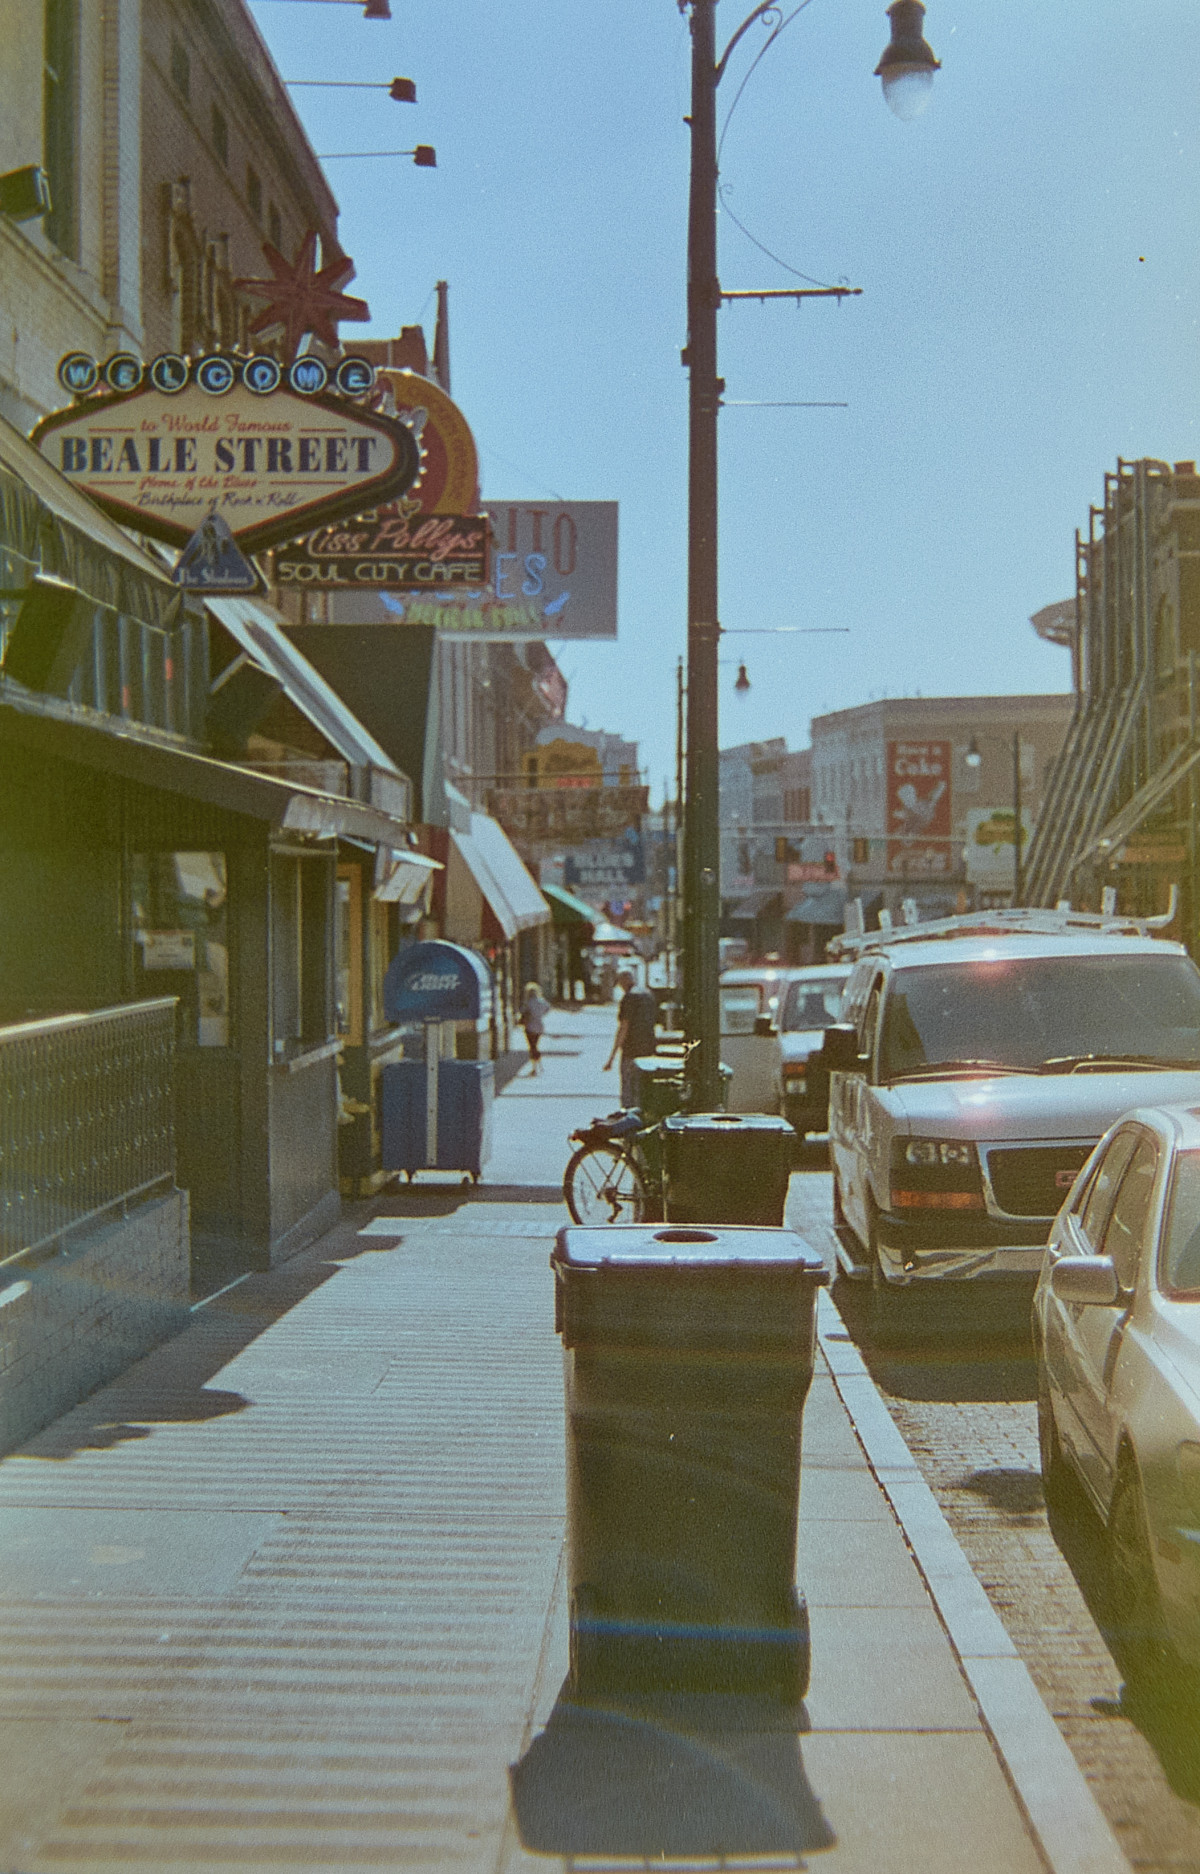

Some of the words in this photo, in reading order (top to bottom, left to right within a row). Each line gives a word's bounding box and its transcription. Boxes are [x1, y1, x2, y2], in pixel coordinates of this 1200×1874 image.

[67, 359, 374, 391] WELCOME
[140, 418, 157, 432] to
[161, 413, 220, 432] World
[224, 413, 293, 432] Famous
[61, 436, 198, 473] BEALE
[214, 436, 377, 473] STREET
[278, 562, 348, 583] SOUL
[355, 562, 408, 581] CITY
[414, 562, 481, 582] CAFE
